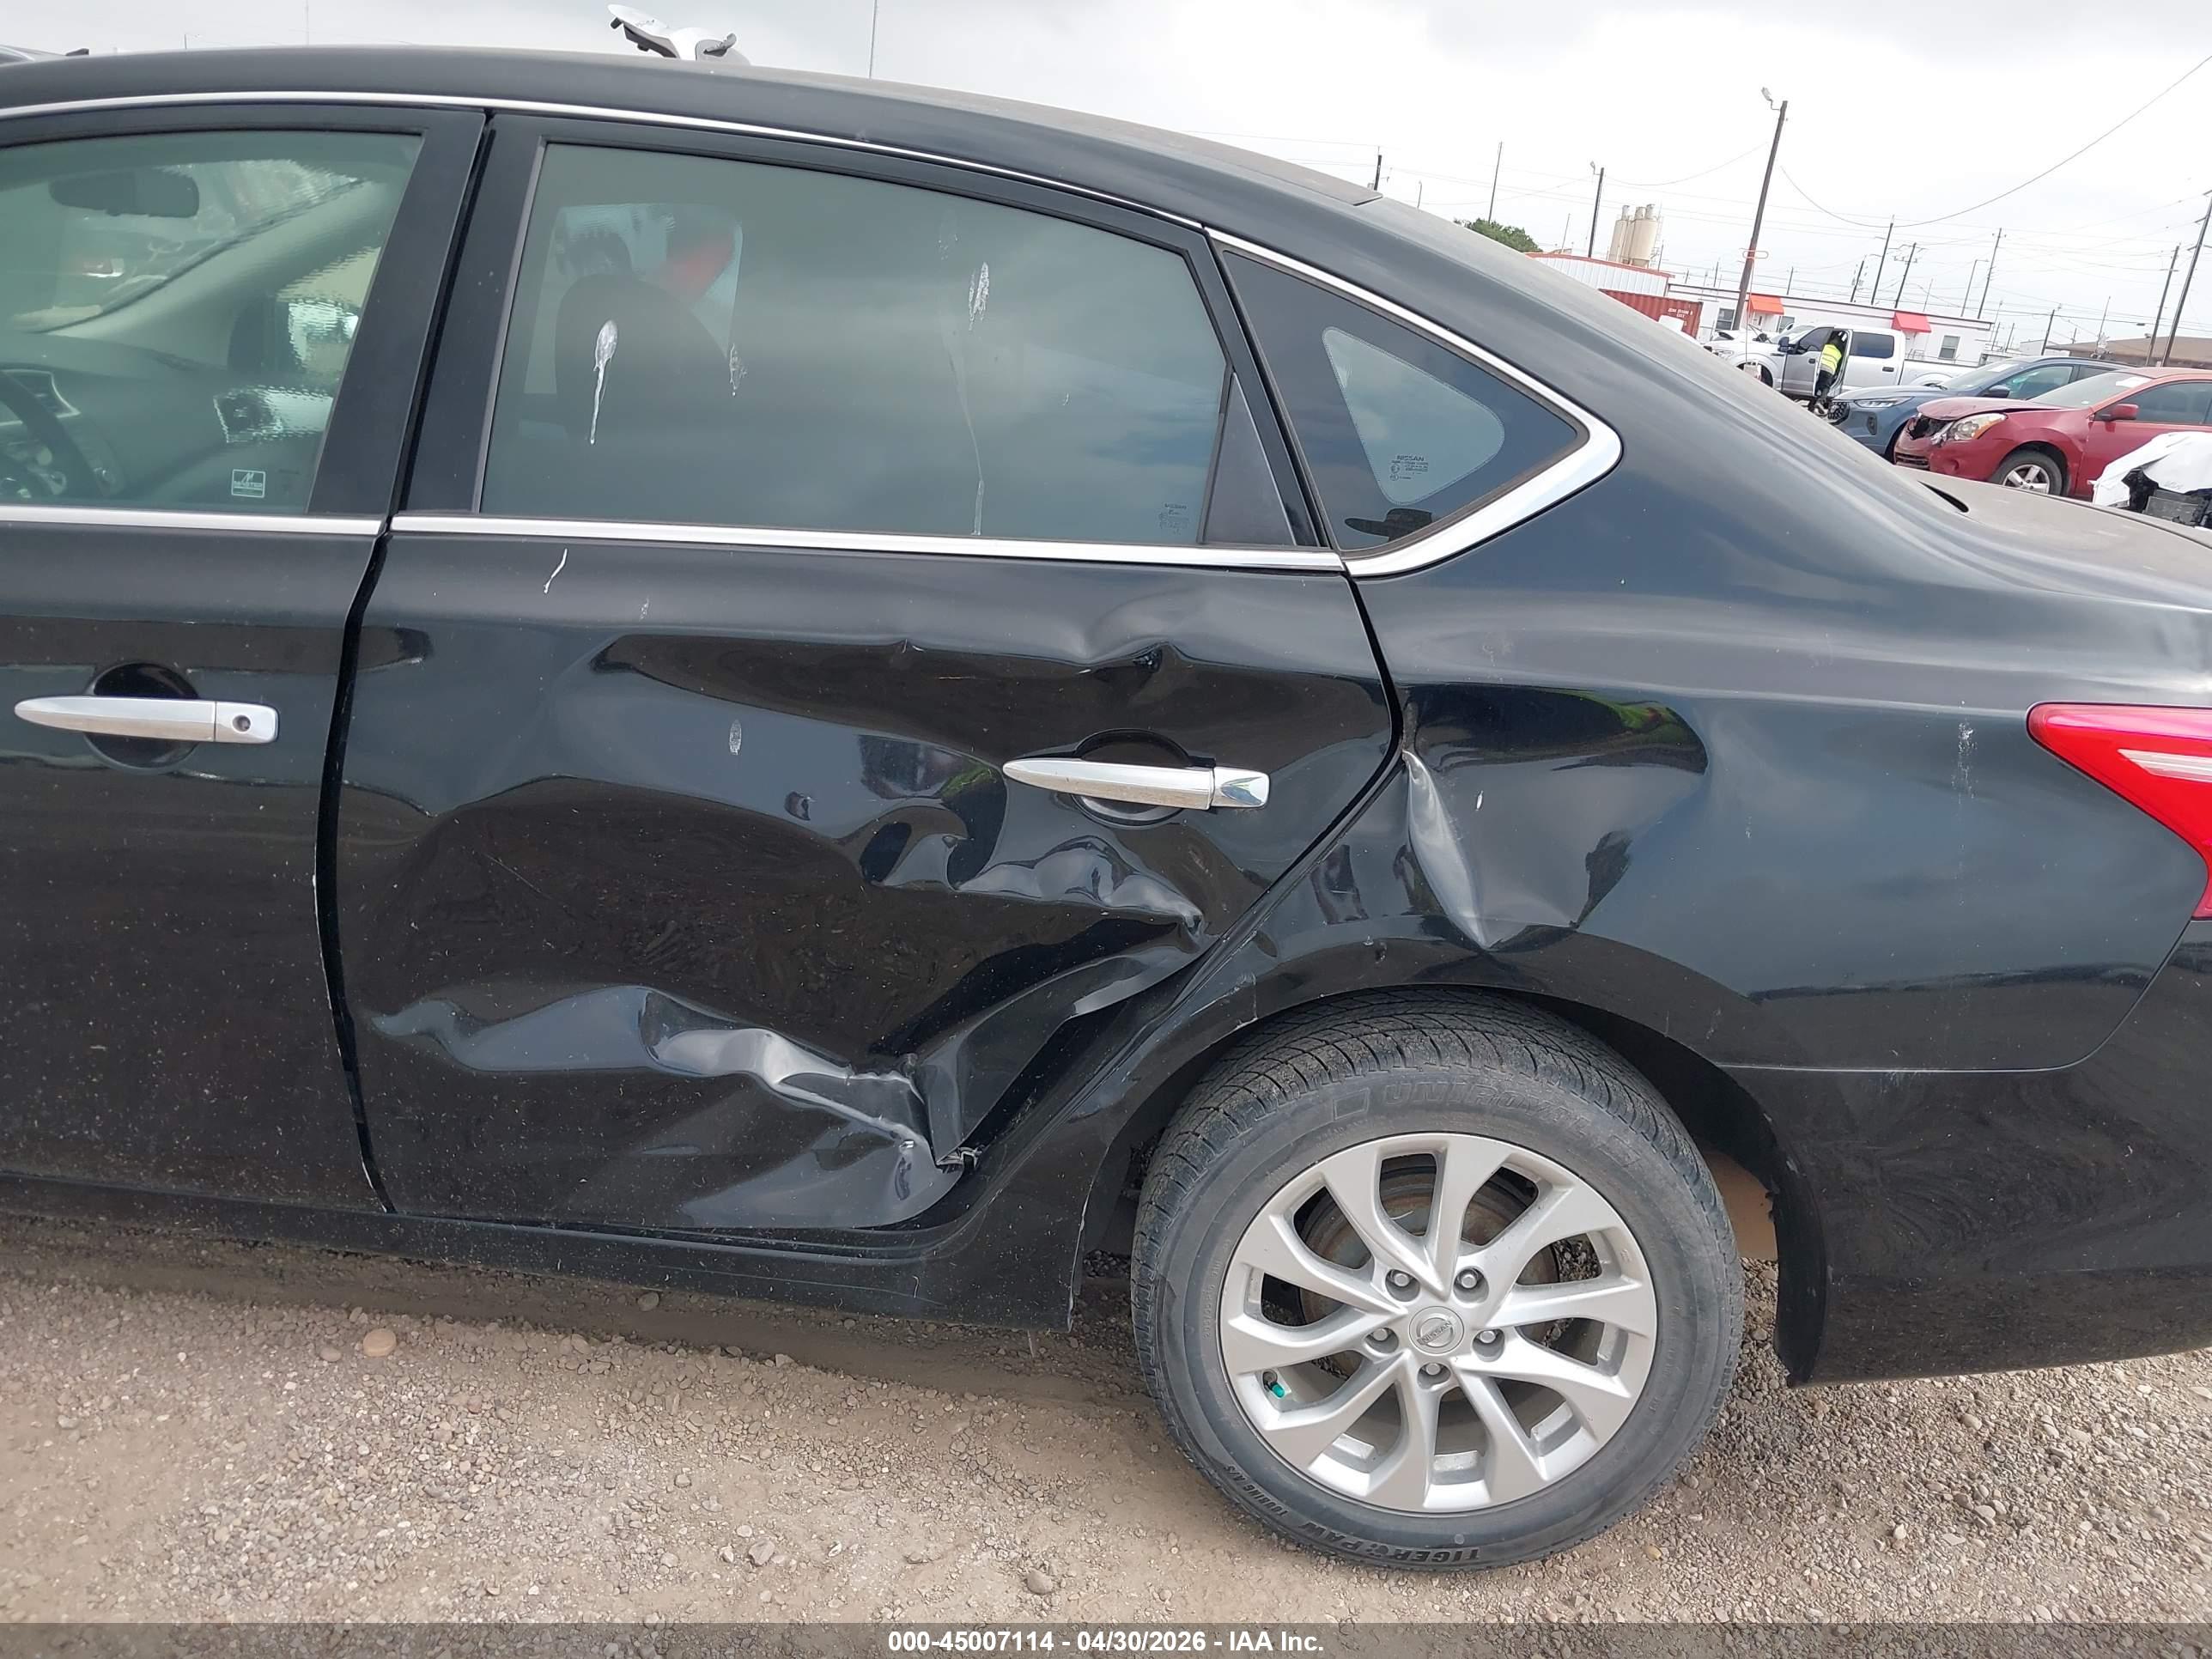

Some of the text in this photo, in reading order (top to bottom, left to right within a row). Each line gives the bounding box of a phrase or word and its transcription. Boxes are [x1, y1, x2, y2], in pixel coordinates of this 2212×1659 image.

[1421, 1320, 1453, 1341] NISSAN
[1223, 1465, 1288, 1516] TOURING A/S
[1298, 1521, 1480, 1563] TIGER PAW
